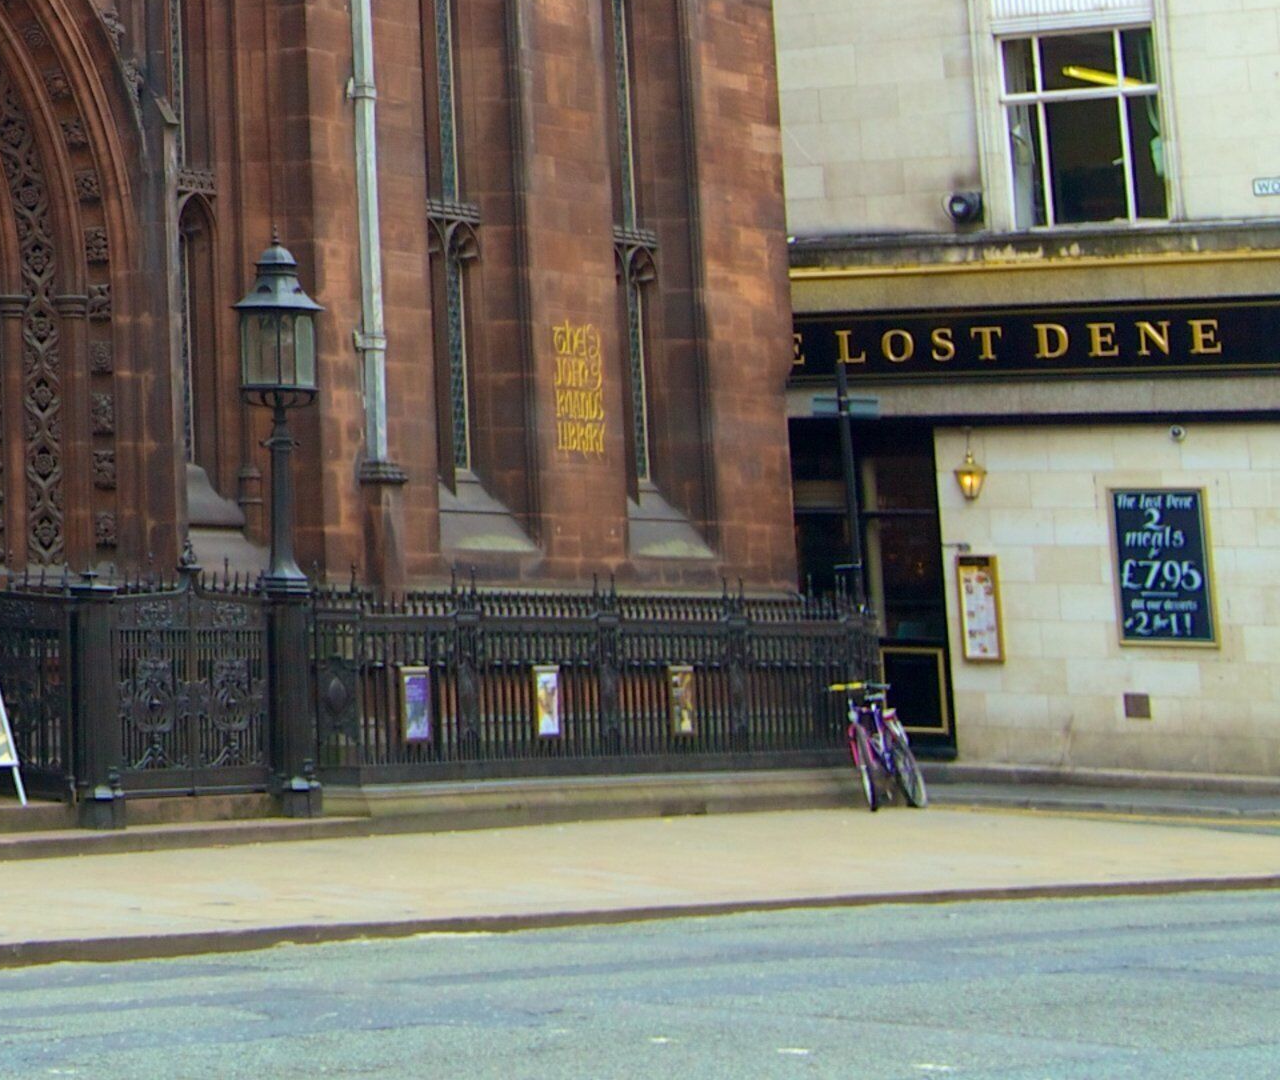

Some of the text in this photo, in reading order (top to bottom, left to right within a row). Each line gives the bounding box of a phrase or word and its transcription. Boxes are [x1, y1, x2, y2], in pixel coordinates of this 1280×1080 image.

[834, 327, 1002, 364] LOST
[1033, 319, 1222, 359] DENE
[1143, 508, 1165, 531] 2
[1125, 526, 1185, 548] meals
[1121, 559, 1202, 591] £7.95
